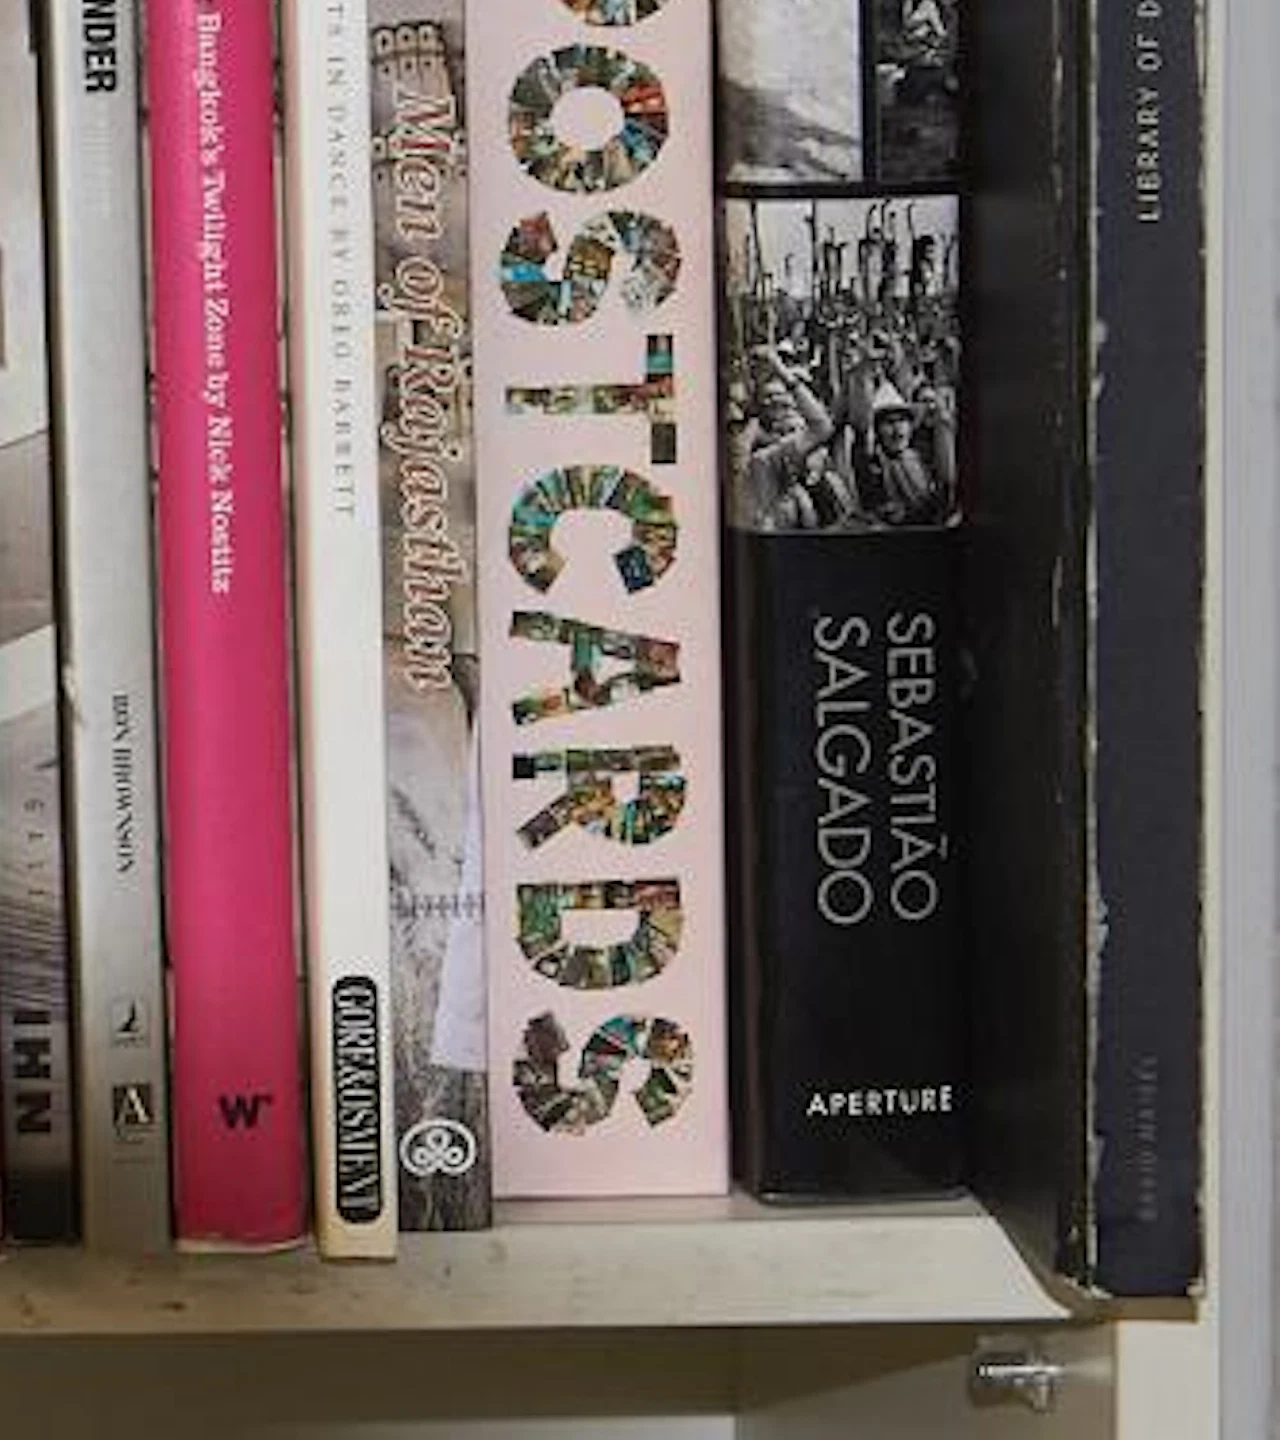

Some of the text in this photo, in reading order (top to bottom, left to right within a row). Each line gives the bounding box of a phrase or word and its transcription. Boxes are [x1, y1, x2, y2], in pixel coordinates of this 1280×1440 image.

[1136, 30, 1162, 72] OF
[378, 82, 456, 240] Men
[1135, 85, 1163, 222] LIBRARY
[202, 373, 231, 409] by
[379, 342, 469, 692] Rajasthan
[812, 615, 876, 924] SALGADO
[886, 612, 949, 921] SEBASTIÃO
[805, 1083, 953, 1117] APERTURE
